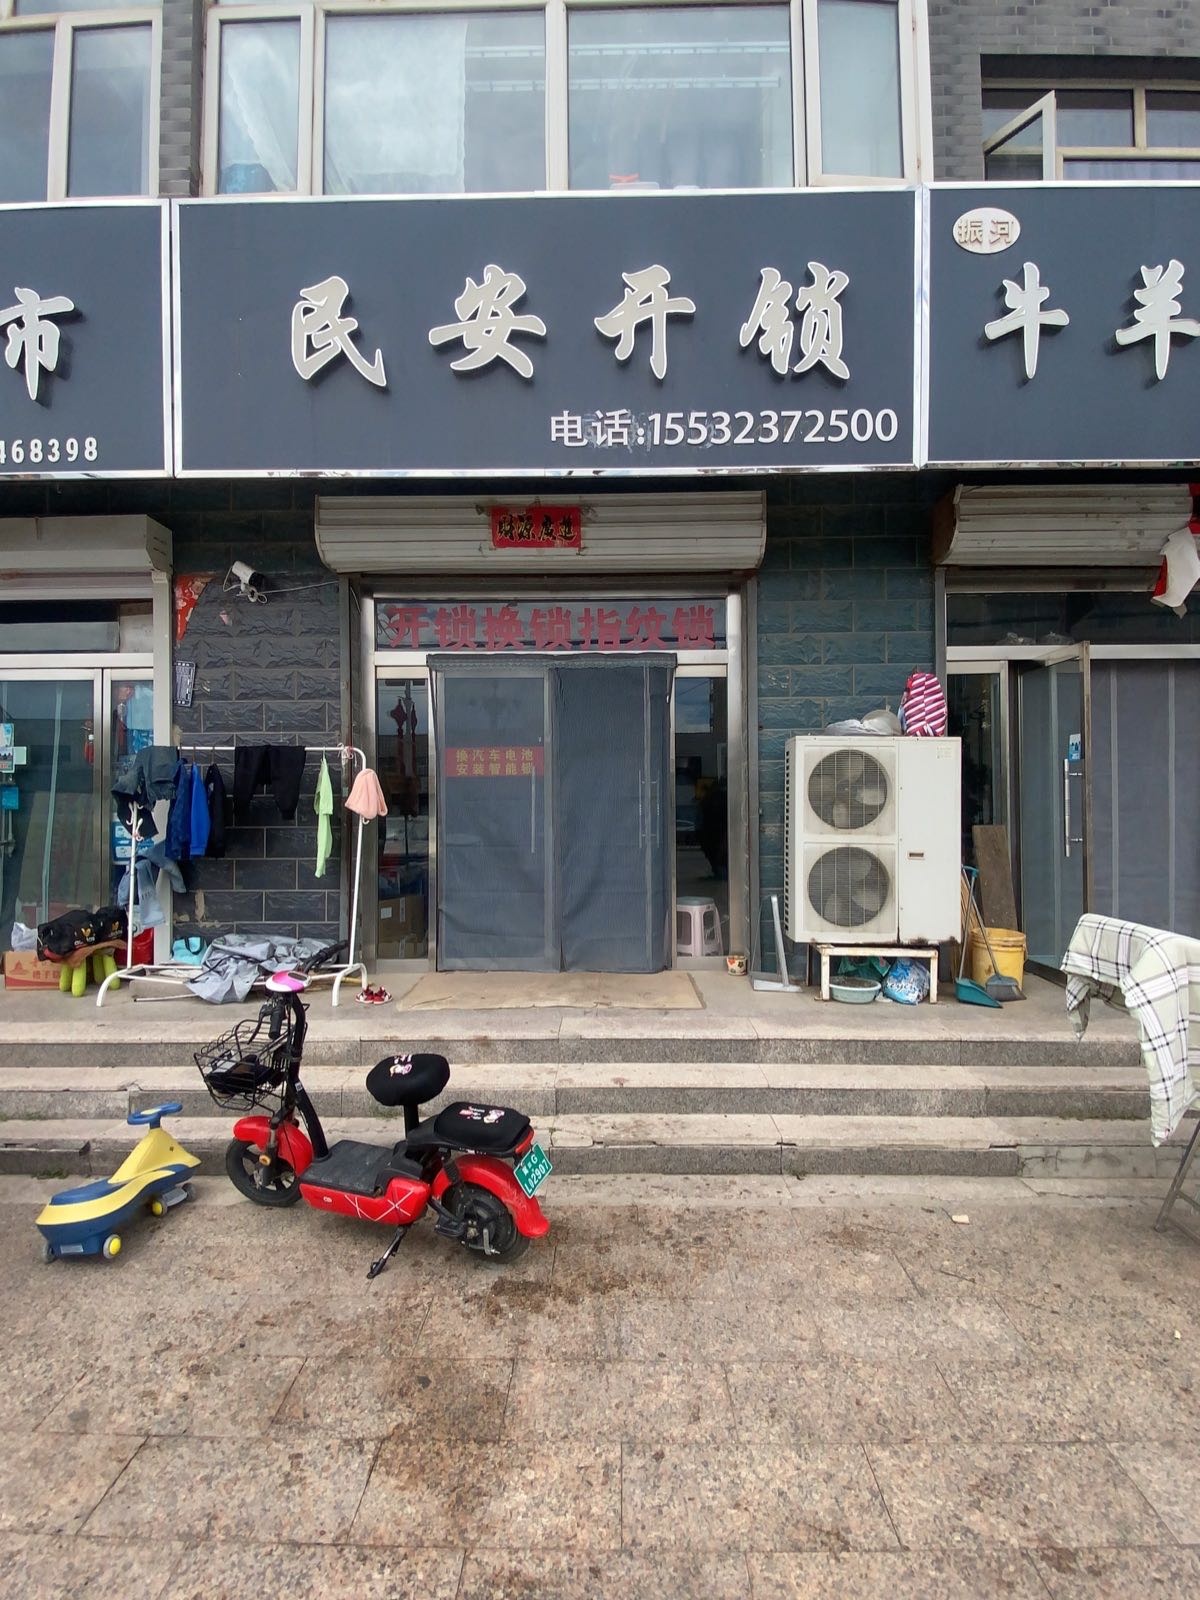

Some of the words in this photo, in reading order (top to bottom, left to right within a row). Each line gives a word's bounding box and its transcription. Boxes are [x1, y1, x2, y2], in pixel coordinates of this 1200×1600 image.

[957, 219, 1015, 245] 振河
[0, 287, 75, 400] 市
[291, 263, 850, 387] 民安开锁
[984, 259, 1200, 380] 牛羊
[387, 604, 715, 649] 开锁换锁指纹锁
